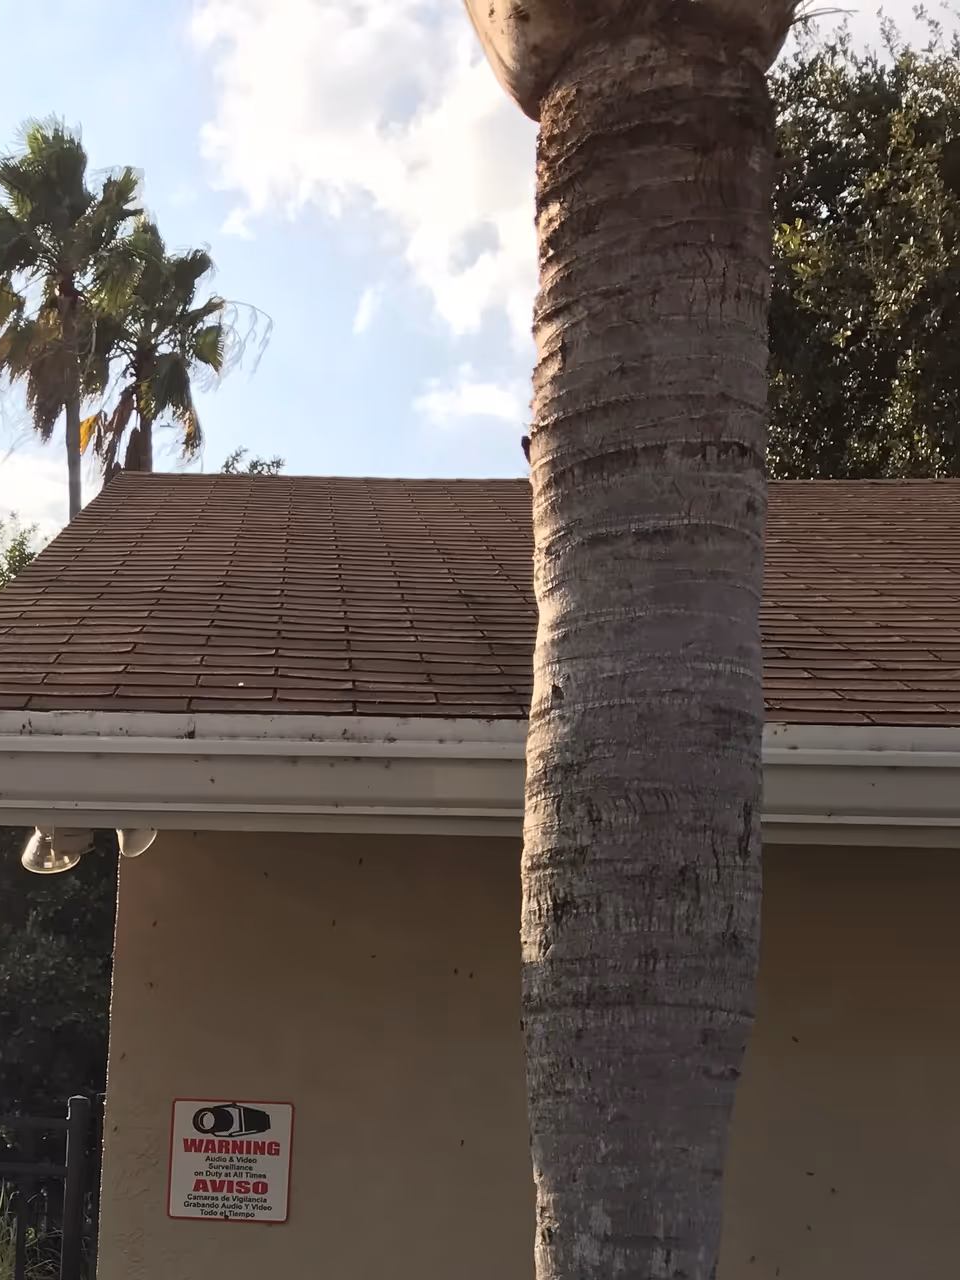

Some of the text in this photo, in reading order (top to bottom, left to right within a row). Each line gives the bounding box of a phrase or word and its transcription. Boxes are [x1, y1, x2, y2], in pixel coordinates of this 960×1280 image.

[183, 1138, 280, 1156] WARNING
[192, 1179, 268, 1194] AVISO
[184, 1201, 219, 1209] Grabando
